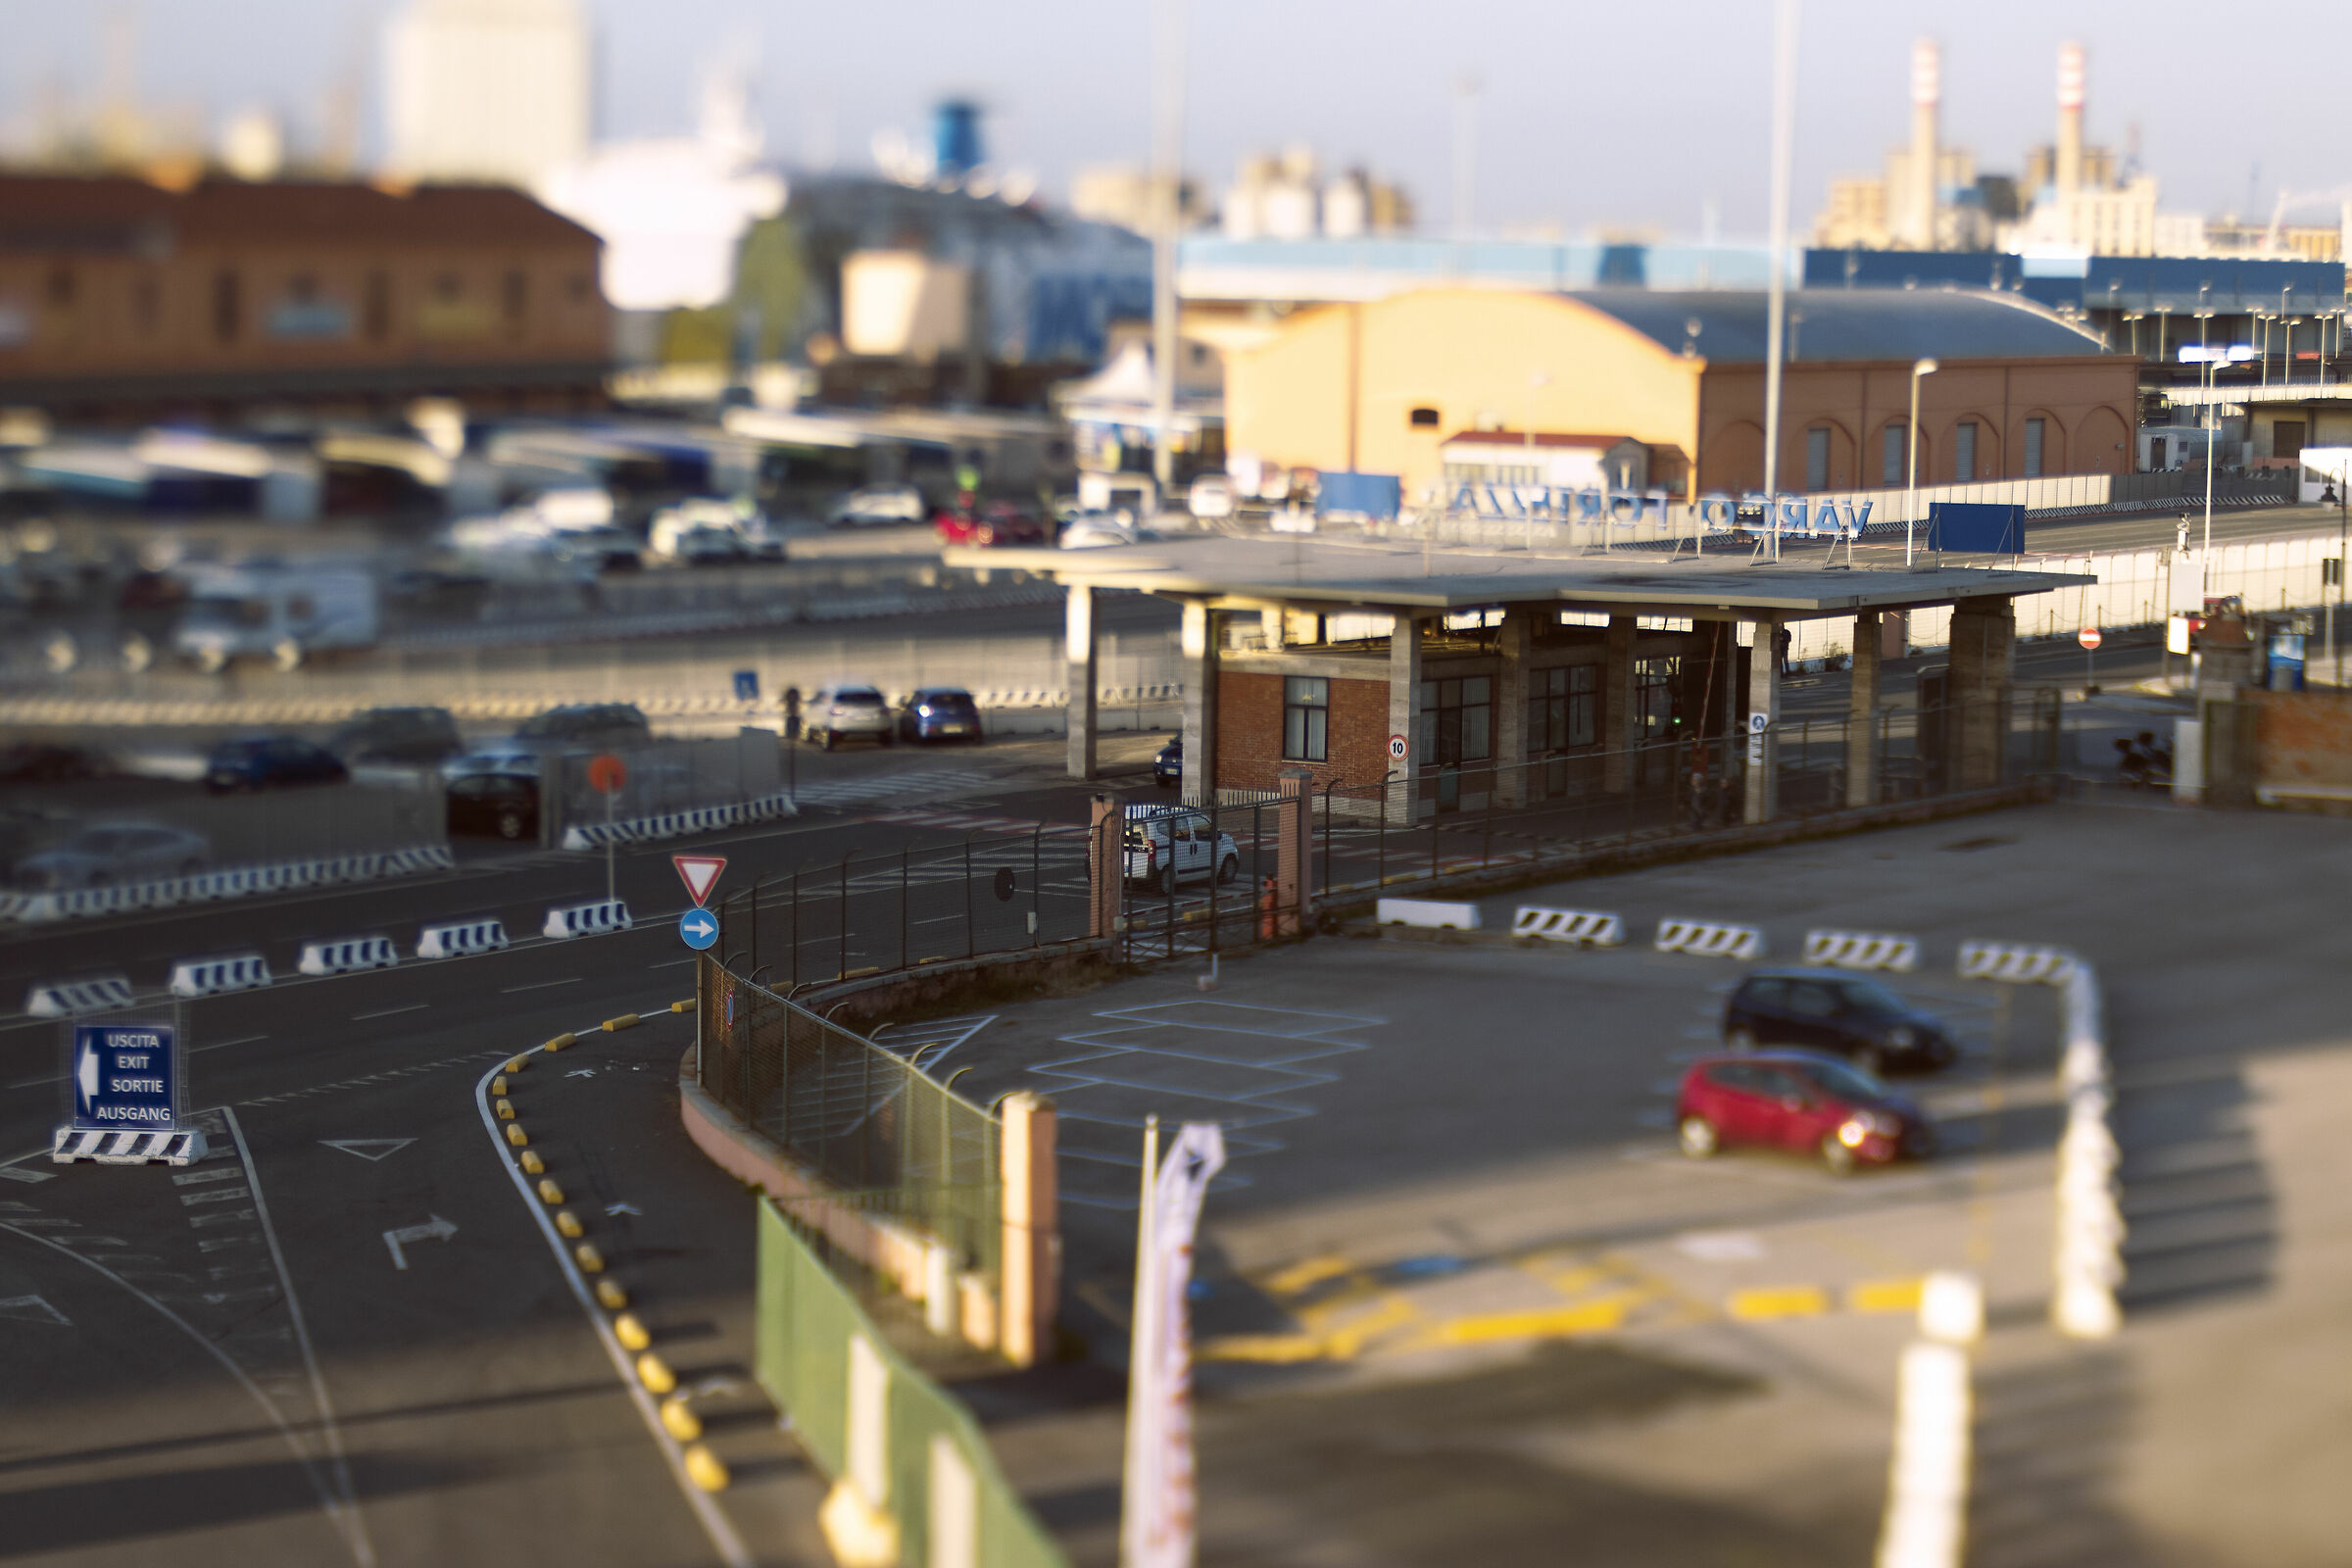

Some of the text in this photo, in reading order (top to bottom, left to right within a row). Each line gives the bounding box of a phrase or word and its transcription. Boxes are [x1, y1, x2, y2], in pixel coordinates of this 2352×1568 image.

[1393, 742, 1403, 755] 10
[108, 1034, 161, 1048] USCITA
[118, 1055, 150, 1069] EXIT
[112, 1079, 164, 1093] SORTIE
[96, 1106, 171, 1121] AUSGANG
